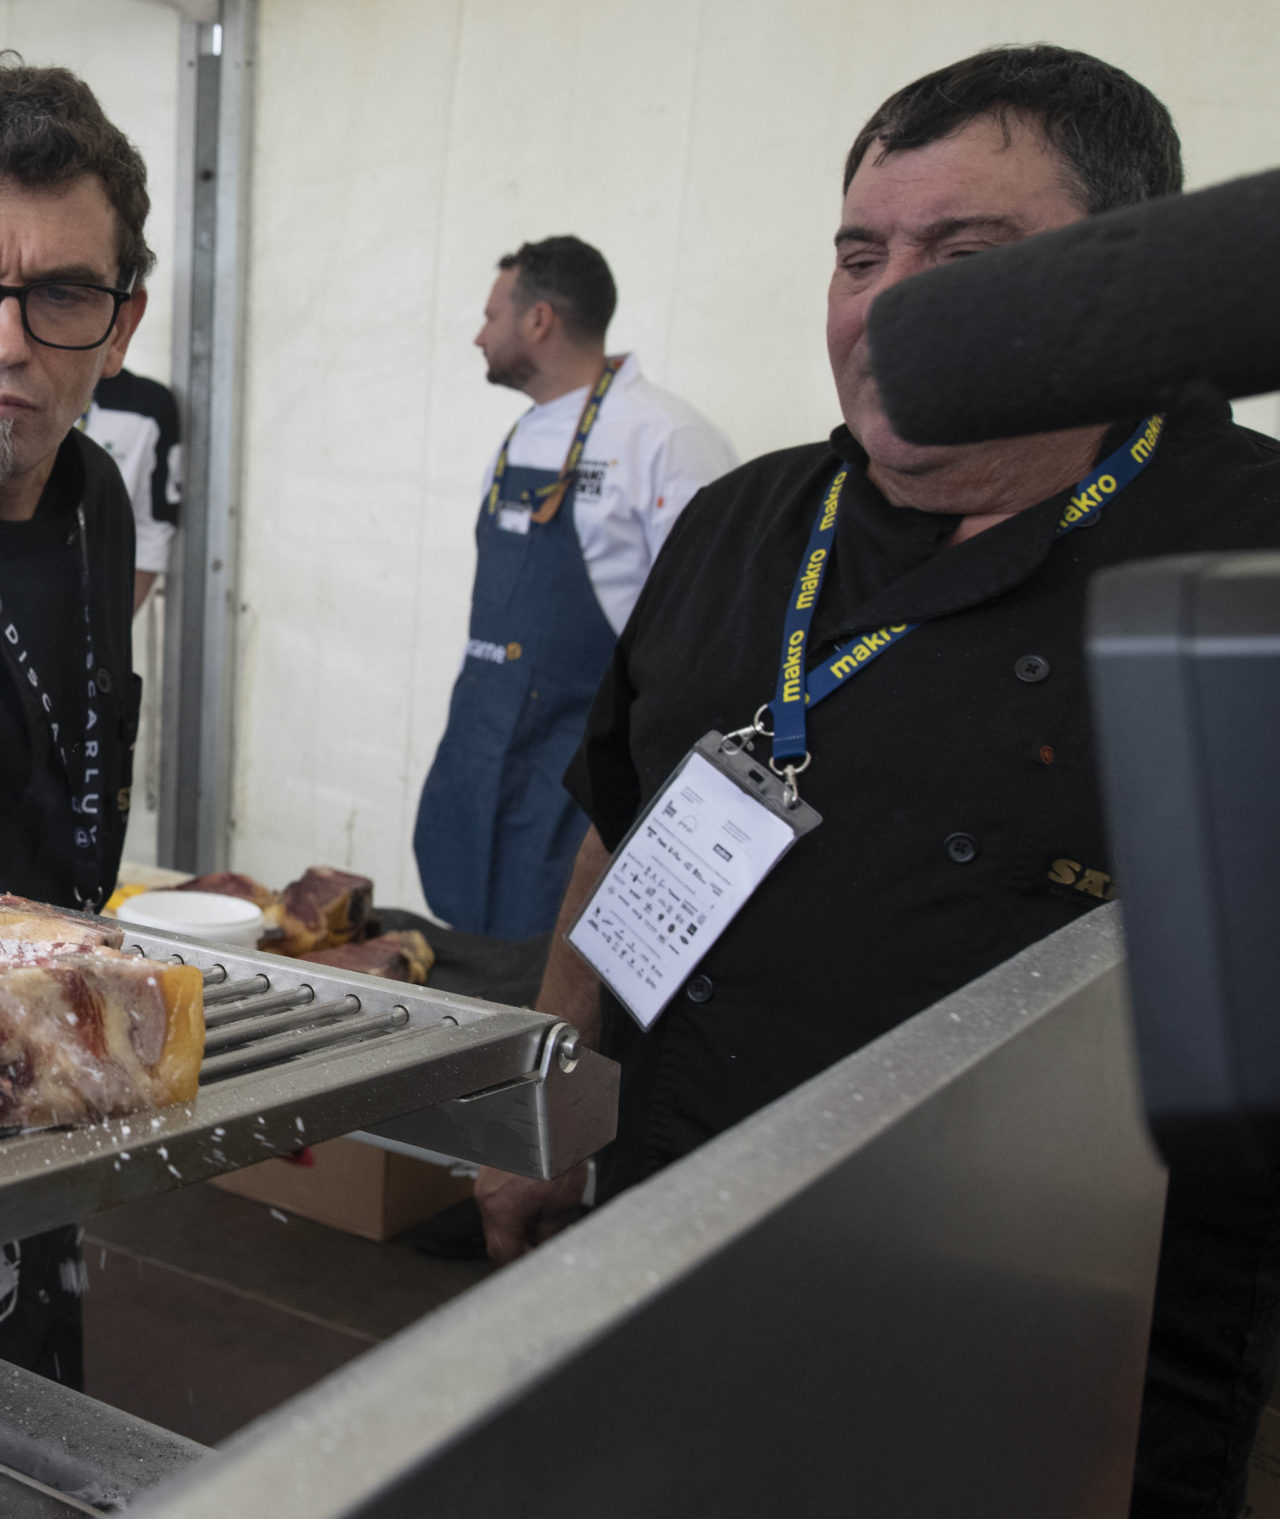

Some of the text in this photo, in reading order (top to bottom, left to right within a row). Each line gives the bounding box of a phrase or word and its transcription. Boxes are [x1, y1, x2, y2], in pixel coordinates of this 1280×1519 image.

[820, 471, 847, 531] makro
[1057, 474, 1117, 532] akro
[796, 548, 827, 609] makro
[4, 623, 67, 766] DISCA
[783, 630, 805, 703] makro
[1048, 858, 1117, 899] SA
